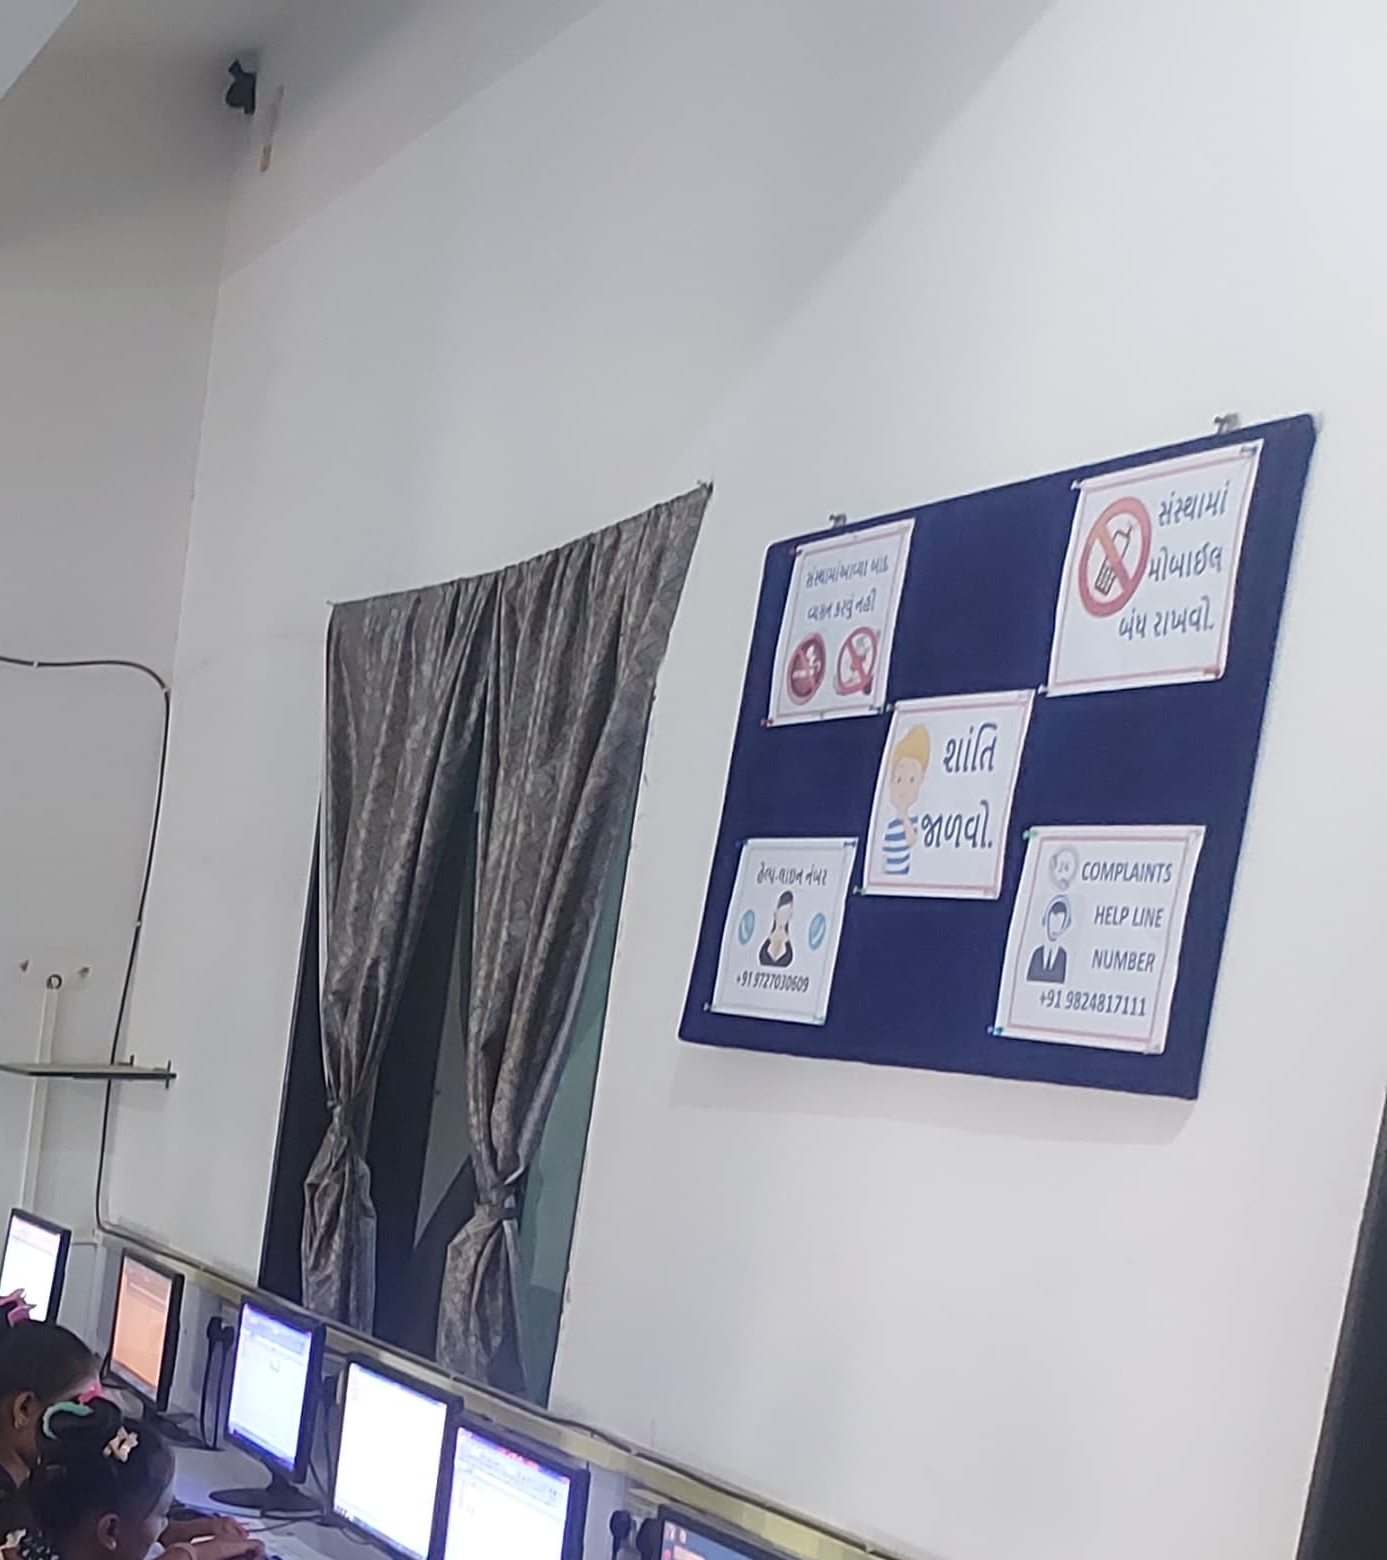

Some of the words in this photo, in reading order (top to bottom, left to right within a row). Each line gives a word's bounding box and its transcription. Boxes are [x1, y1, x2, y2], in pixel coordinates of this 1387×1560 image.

[1158, 480, 1230, 526] સંસ્થામાં
[1148, 542, 1223, 582] મોબાઈલ
[943, 722, 997, 773] શાંતિ
[921, 800, 993, 849] જાળવો.
[1081, 862, 1172, 884] COMPLAINTS
[1094, 905, 1129, 927] HELP
[1131, 908, 1164, 929] LINE
[1091, 949, 1156, 973] NUMBER
[737, 971, 753, 987] +91
[1039, 989, 1062, 1009] +91
[1064, 991, 1147, 1017] 9824817111
